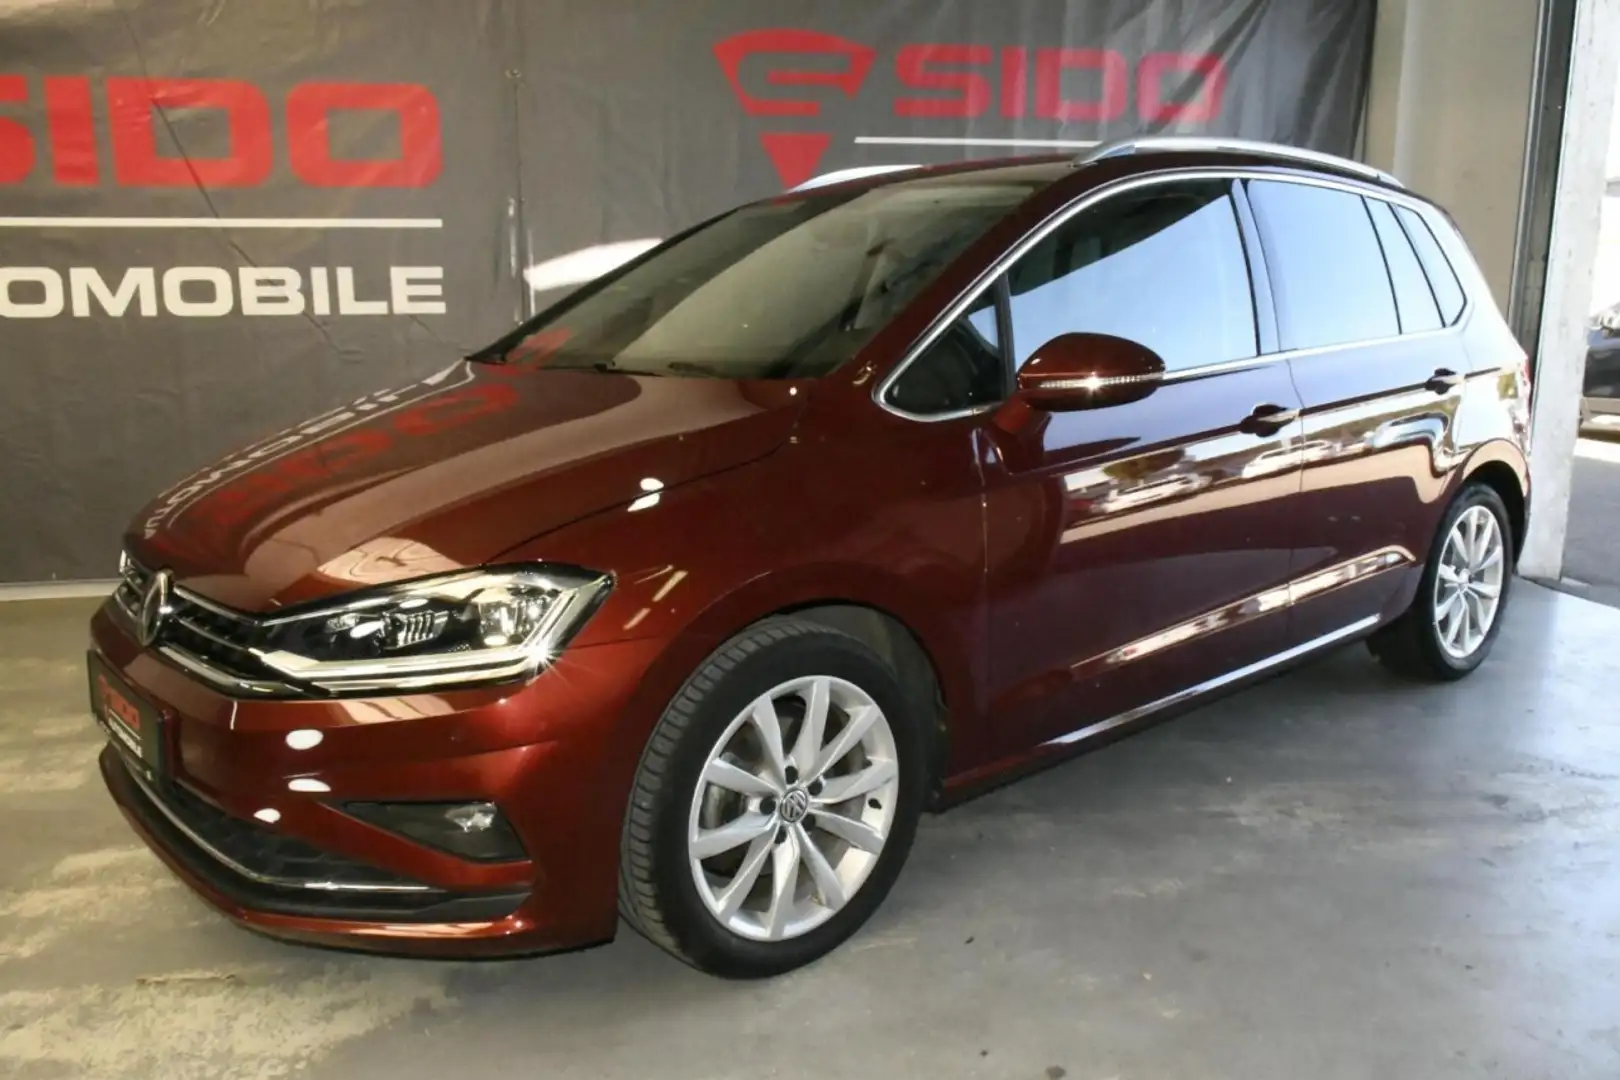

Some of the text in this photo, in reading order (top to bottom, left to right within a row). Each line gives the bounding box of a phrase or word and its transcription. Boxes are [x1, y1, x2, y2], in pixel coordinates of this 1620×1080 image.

[893, 44, 1228, 123] SIDO
[0, 73, 443, 188] IDO
[0, 266, 446, 318] OMOBILE
